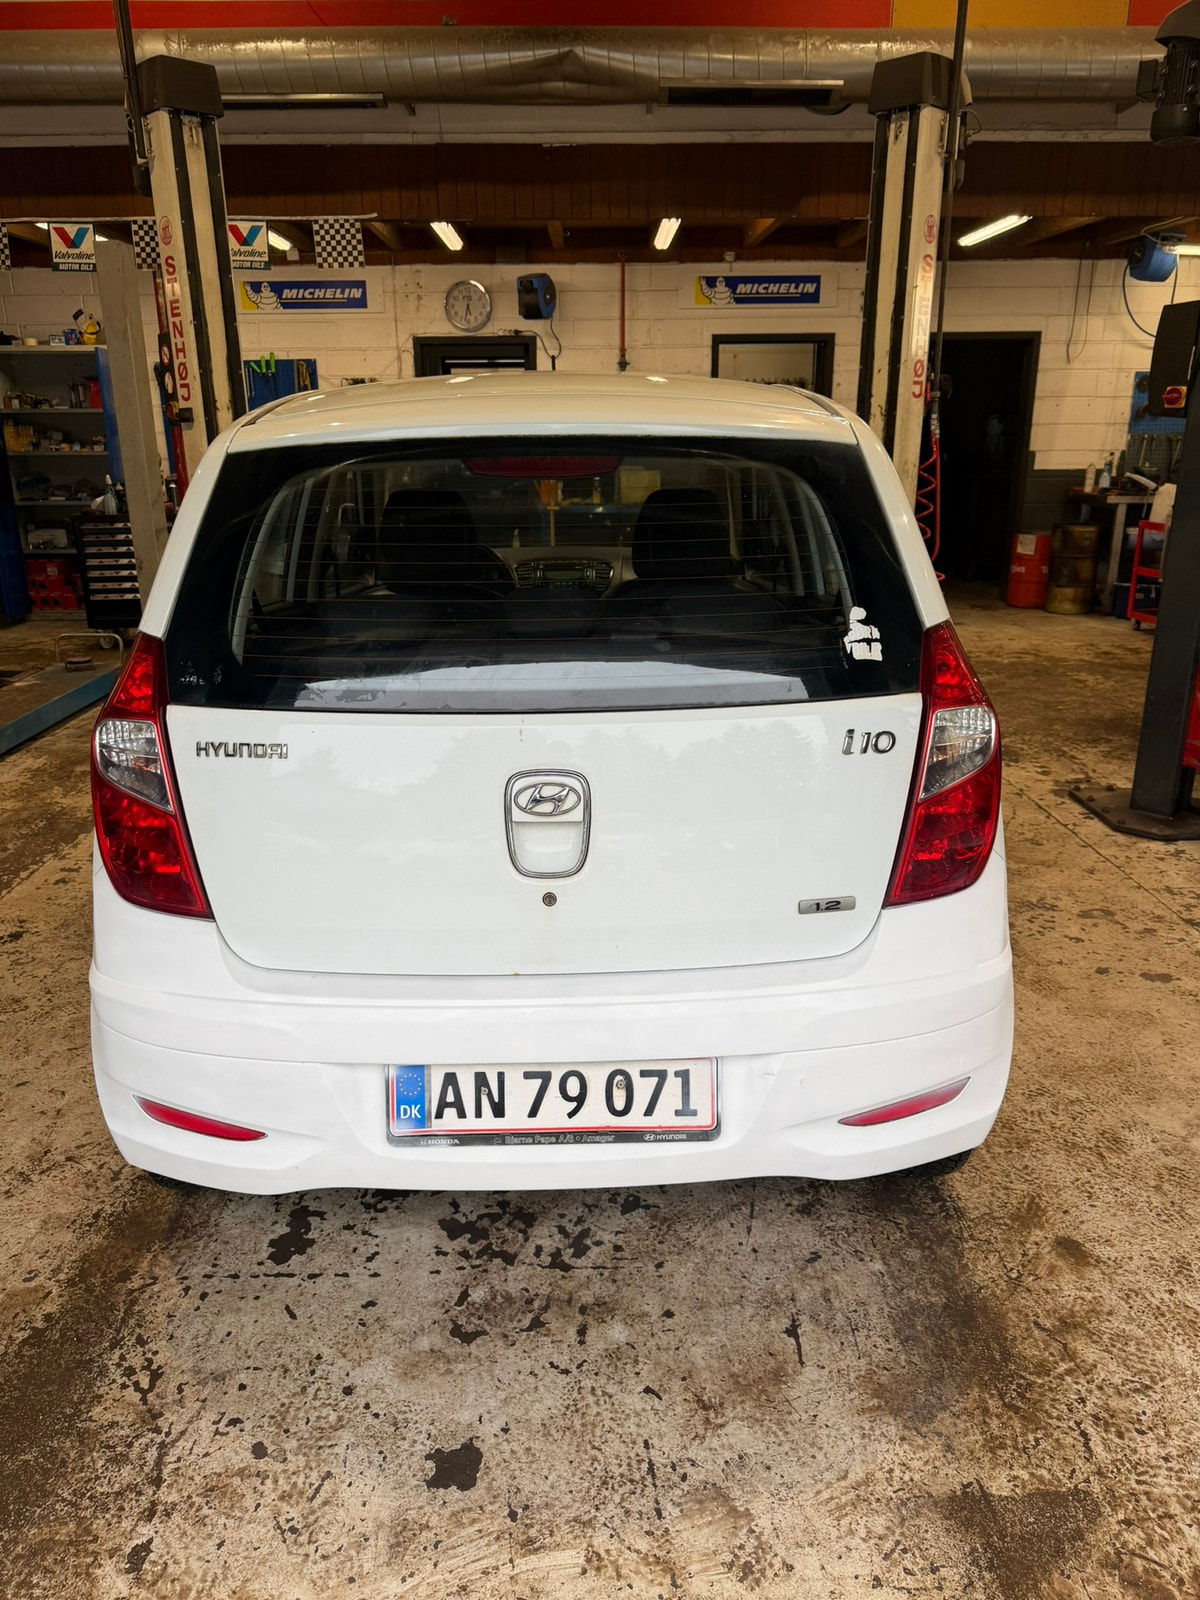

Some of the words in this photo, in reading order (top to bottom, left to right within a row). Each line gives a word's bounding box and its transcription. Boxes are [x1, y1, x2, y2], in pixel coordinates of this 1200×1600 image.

[54, 250, 95, 260] Valvoline
[231, 248, 267, 259] alvoline
[251, 261, 265, 269] OILS
[281, 288, 363, 299] MICHELIN
[736, 283, 817, 294] MICHELIN
[164, 255, 191, 402] STENHØJ
[196, 741, 288, 759] HYUNDAI
[815, 900, 841, 911] 1.2
[434, 1071, 505, 1119] AN
[523, 1070, 587, 1119] 79
[605, 1068, 697, 1117] 071
[400, 1104, 421, 1119] DK
